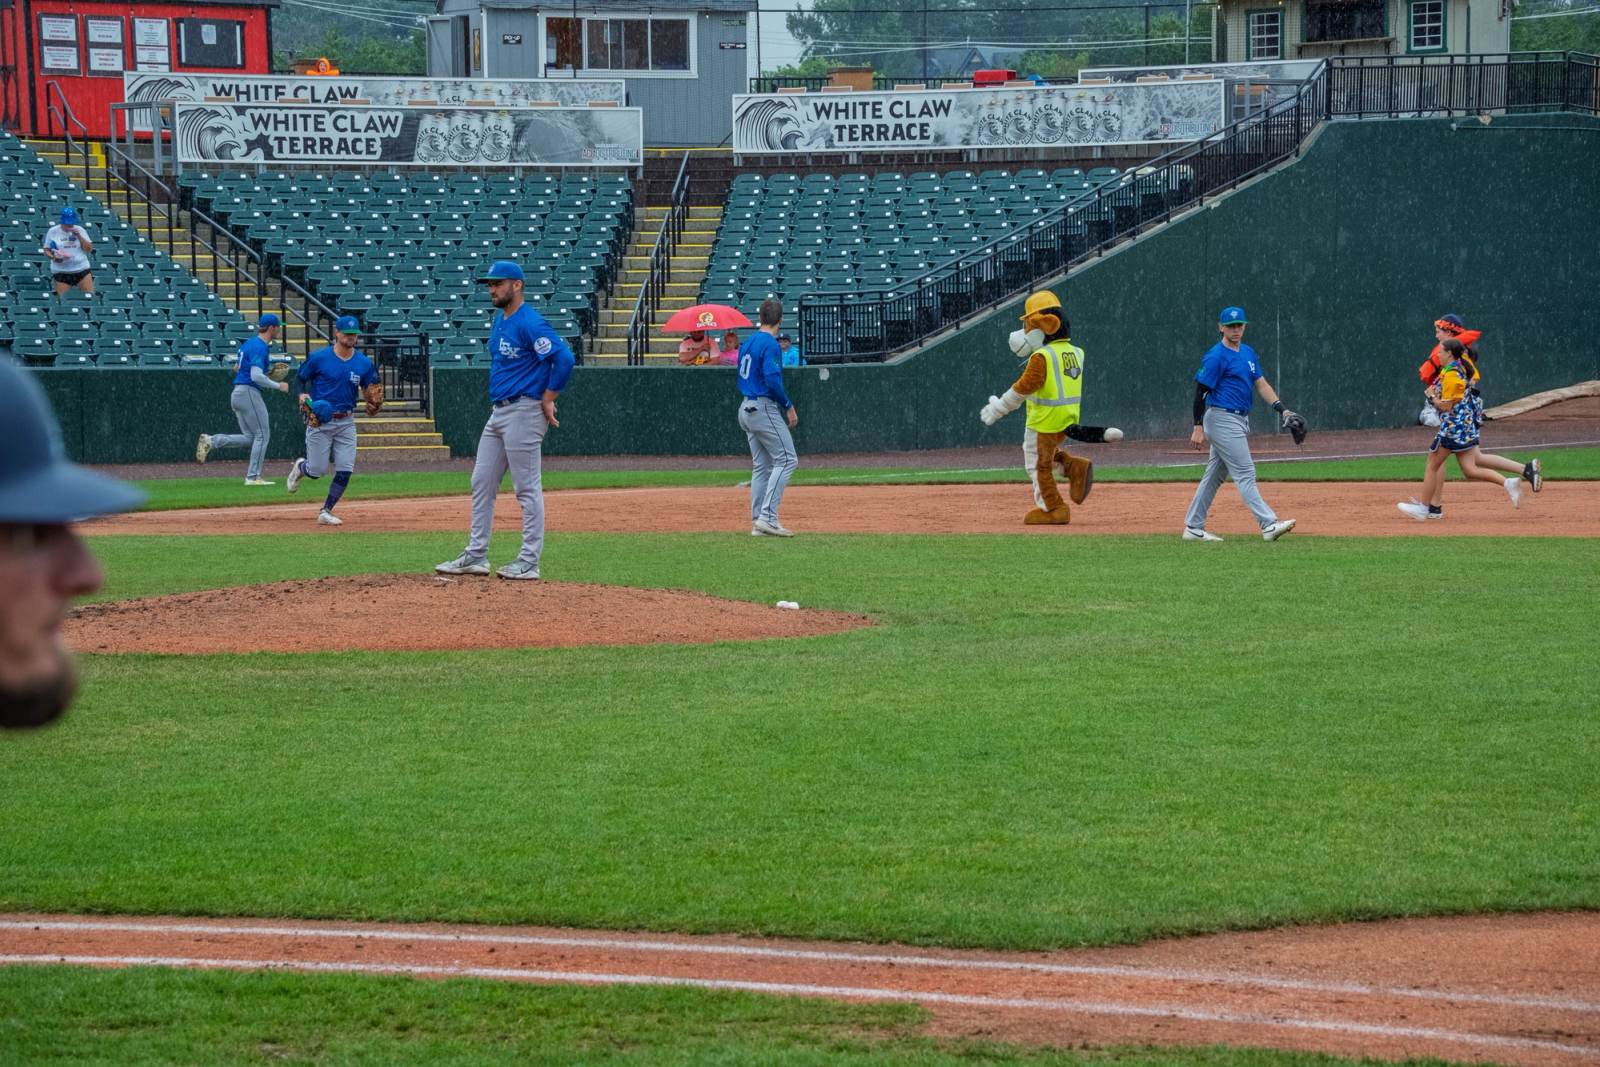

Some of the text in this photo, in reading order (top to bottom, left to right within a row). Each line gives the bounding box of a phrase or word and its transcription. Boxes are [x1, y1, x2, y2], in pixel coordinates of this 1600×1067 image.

[212, 83, 358, 103] WHITE CLAW
[813, 99, 952, 120] WHITE CLAW
[250, 112, 400, 134] WHITE CLAW
[834, 122, 931, 142] TERRACE
[274, 135, 378, 156] TERRACE
[739, 354, 752, 380] 0
[1062, 352, 1080, 369] 811
